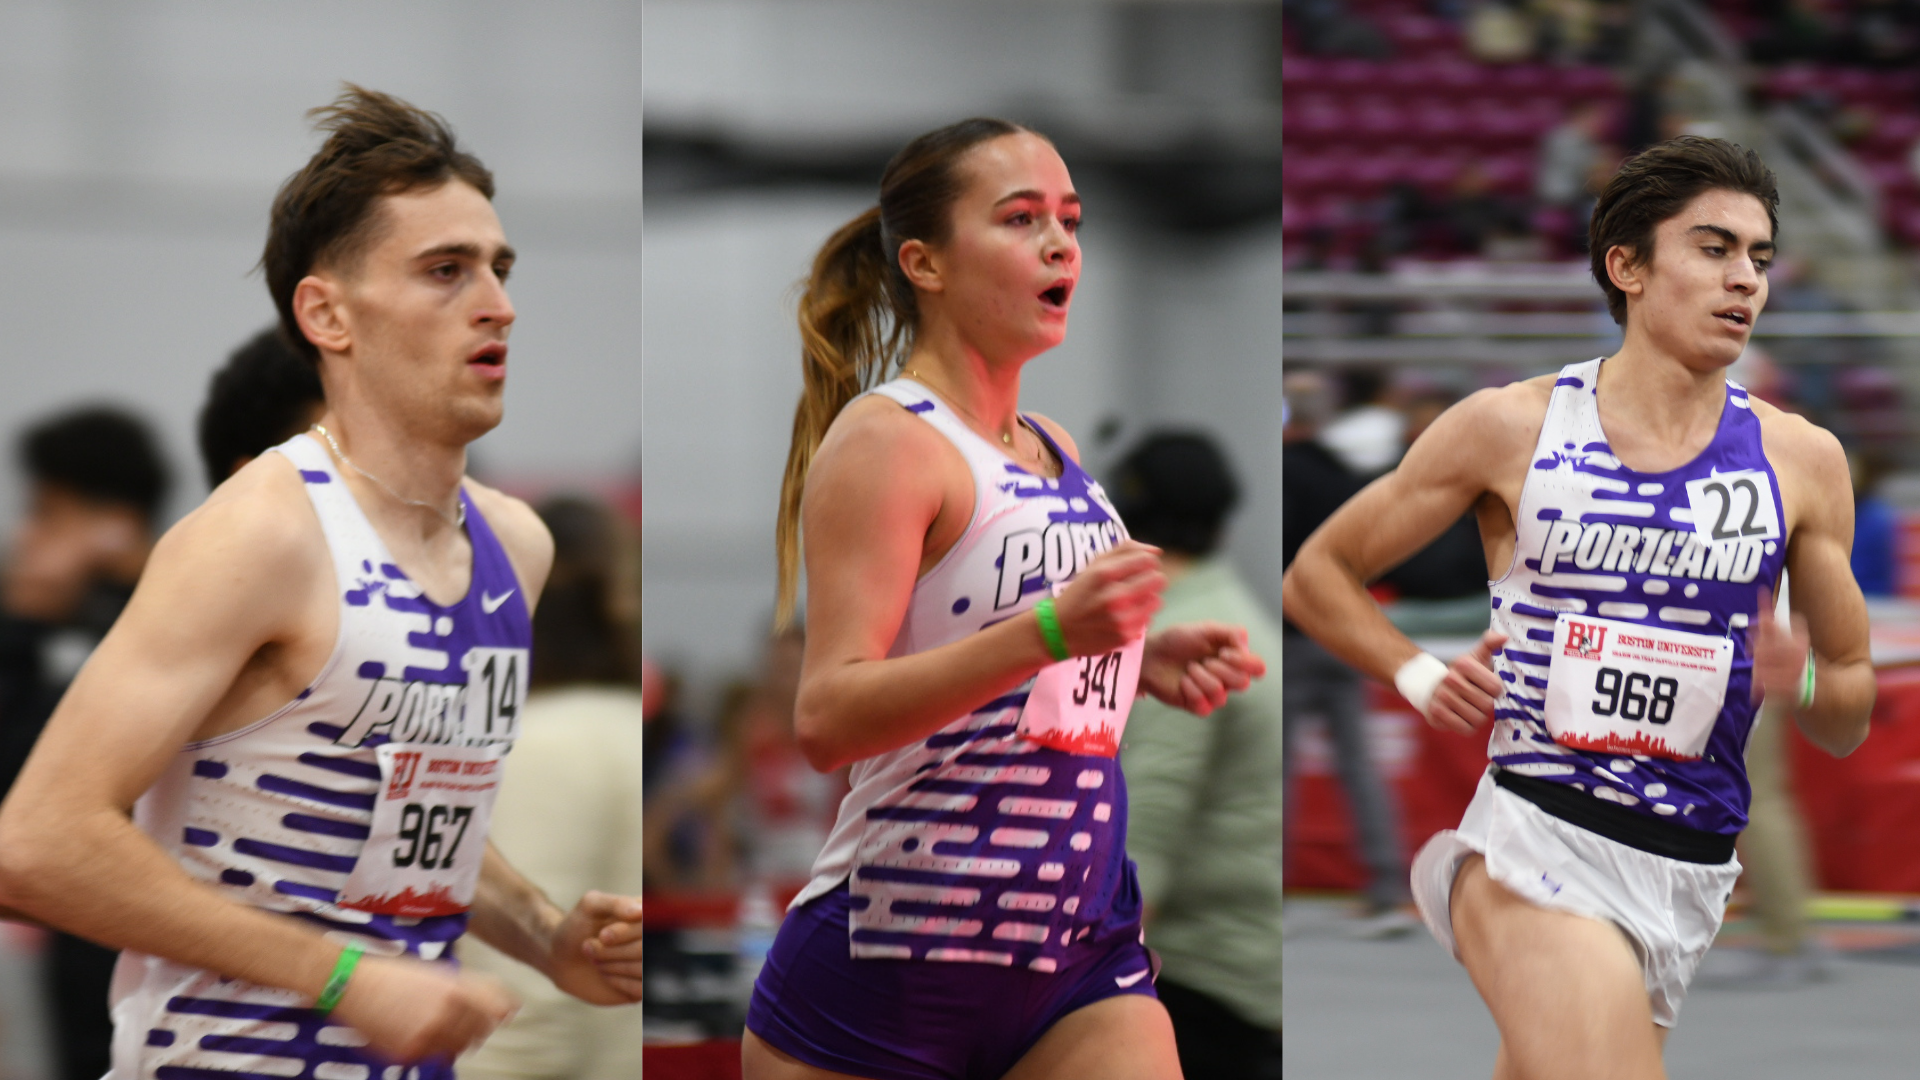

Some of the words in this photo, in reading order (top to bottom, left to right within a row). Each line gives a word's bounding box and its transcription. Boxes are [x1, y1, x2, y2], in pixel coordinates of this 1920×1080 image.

[1702, 478, 1768, 541] 22
[1539, 519, 1766, 584] PORTLAND
[1565, 621, 1608, 653] BU
[1618, 633, 1655, 649] BOSTON
[1657, 640, 1717, 659] UNIVERSITY
[482, 654, 517, 735] 14
[1073, 651, 1122, 711] 347
[1592, 666, 1679, 725] 968
[393, 804, 475, 870] 967
